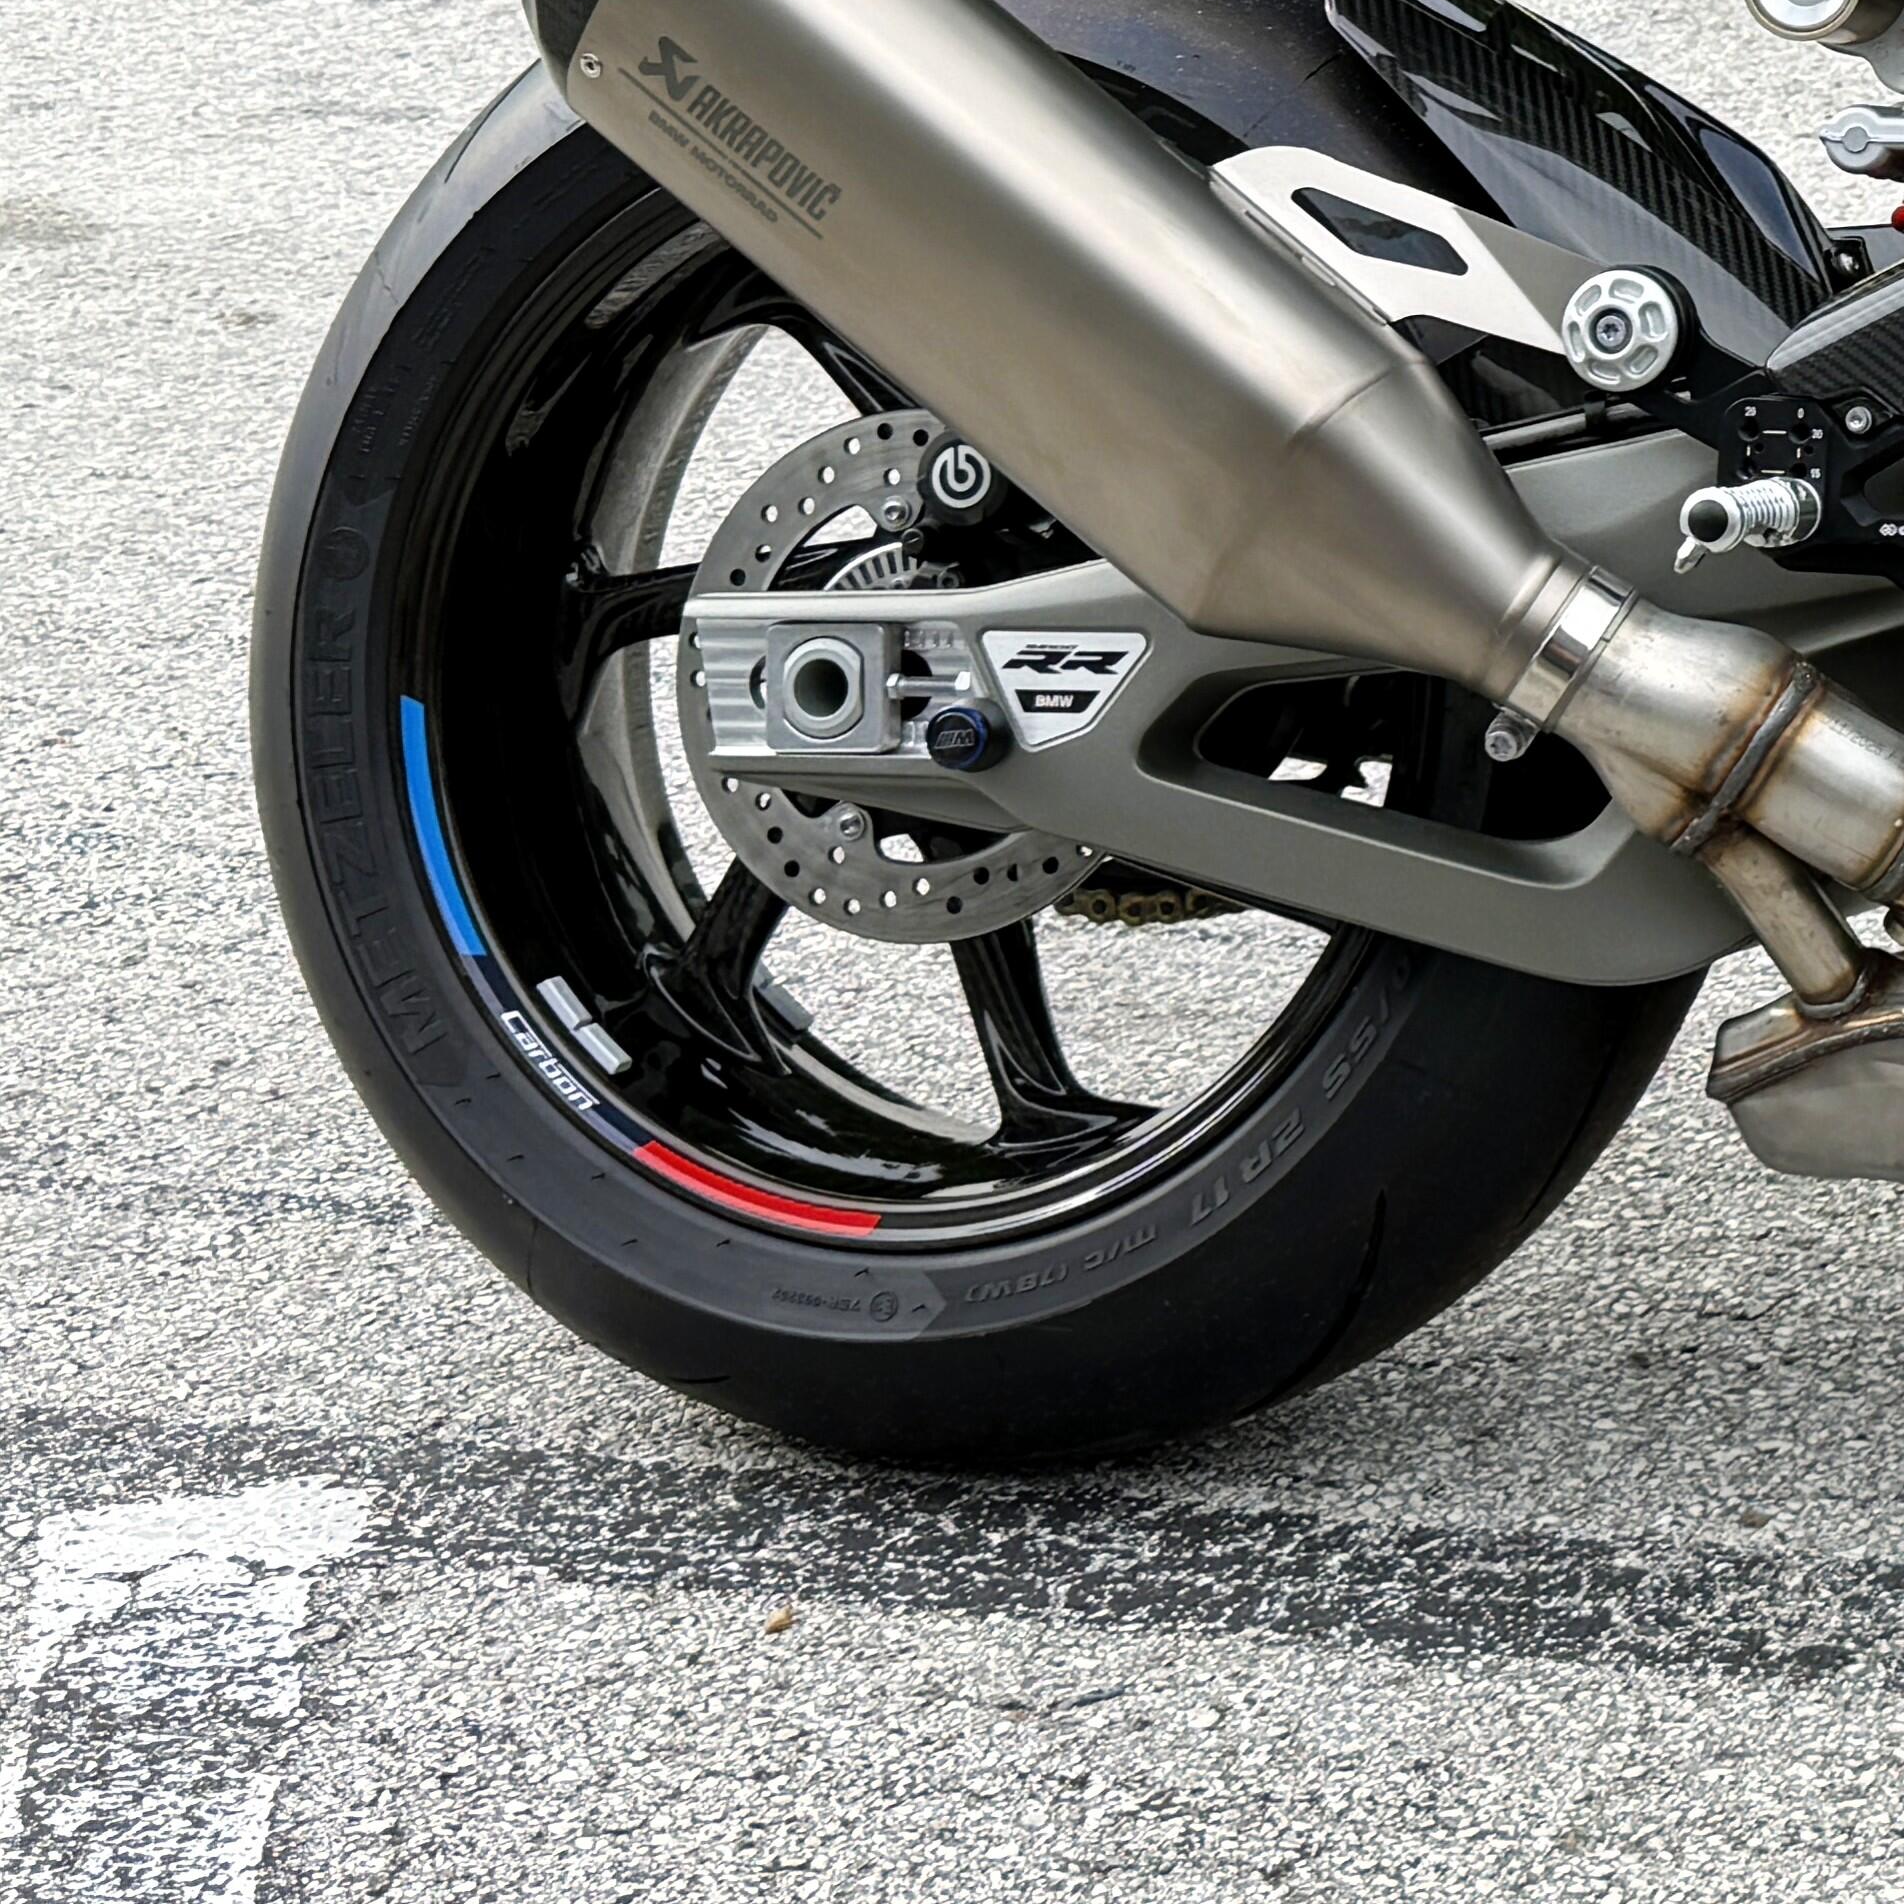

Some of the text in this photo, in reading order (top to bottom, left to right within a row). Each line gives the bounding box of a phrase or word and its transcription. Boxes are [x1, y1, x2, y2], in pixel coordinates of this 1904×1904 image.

[648, 109, 780, 224] BMW MOTORRAD
[1001, 650, 1130, 675] RR
[1034, 695, 1075, 708] BMW
[307, 607, 449, 1054] METZELER
